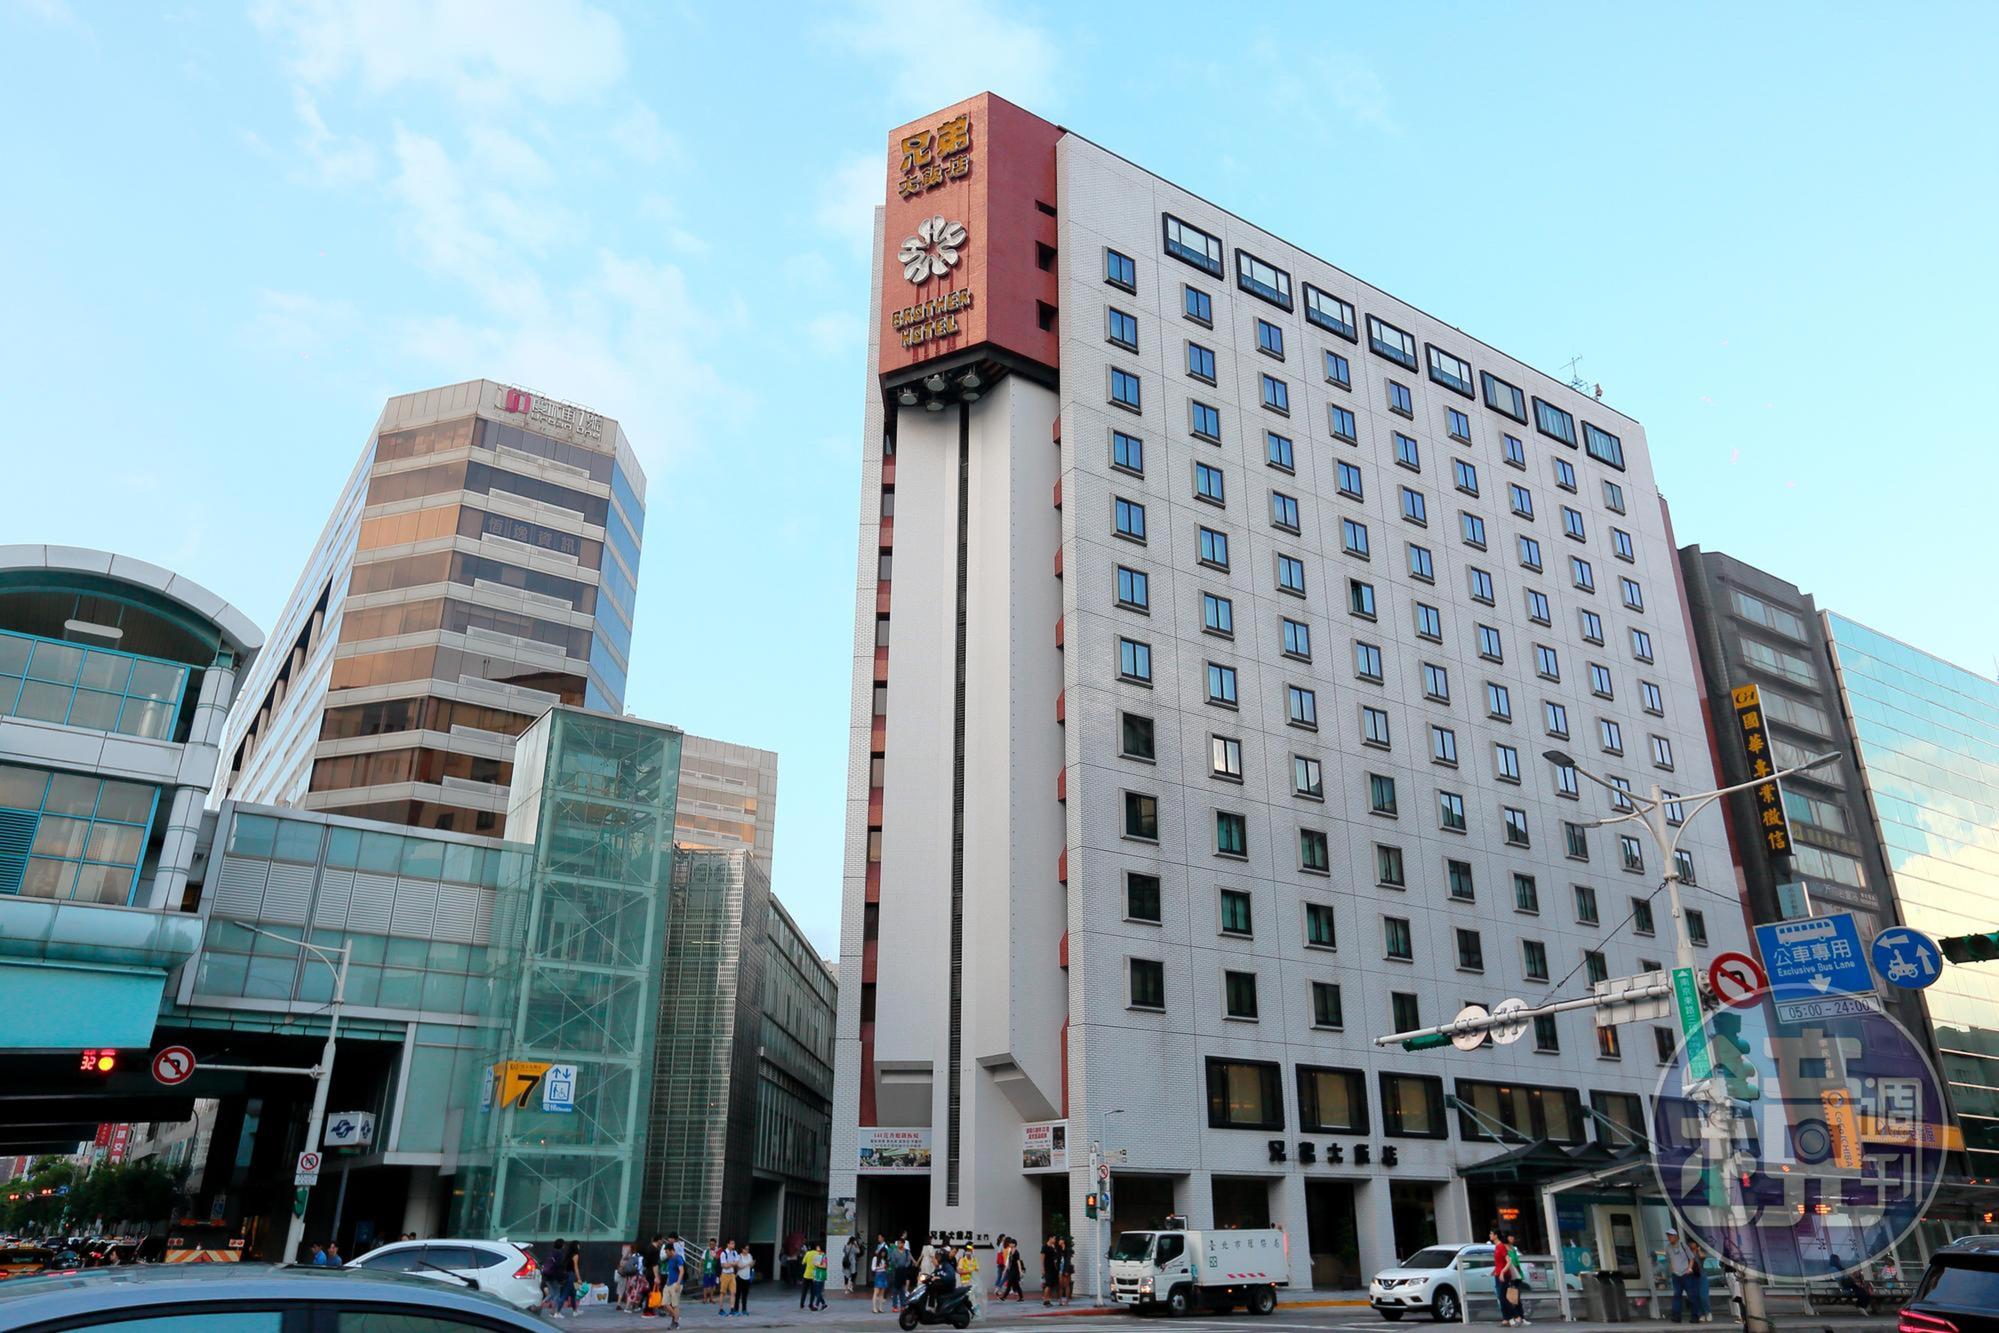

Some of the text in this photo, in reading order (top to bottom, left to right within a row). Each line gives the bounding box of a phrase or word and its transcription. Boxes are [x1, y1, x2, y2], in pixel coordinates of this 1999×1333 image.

[900, 114, 970, 172] 兄弟
[899, 154, 970, 198] 大飯店
[892, 287, 971, 328] BROTHER
[901, 315, 959, 347] HOTEL
[1742, 711, 1786, 850] 國華專業徵信
[1773, 939, 1852, 966] 公車專用
[1777, 960, 1856, 977] Exclusive Bus Lane
[1788, 1004, 1822, 1019] 05:00
[1834, 999, 1870, 1013] 24:00
[80, 1055, 96, 1070] 32
[518, 1074, 540, 1107] 7
